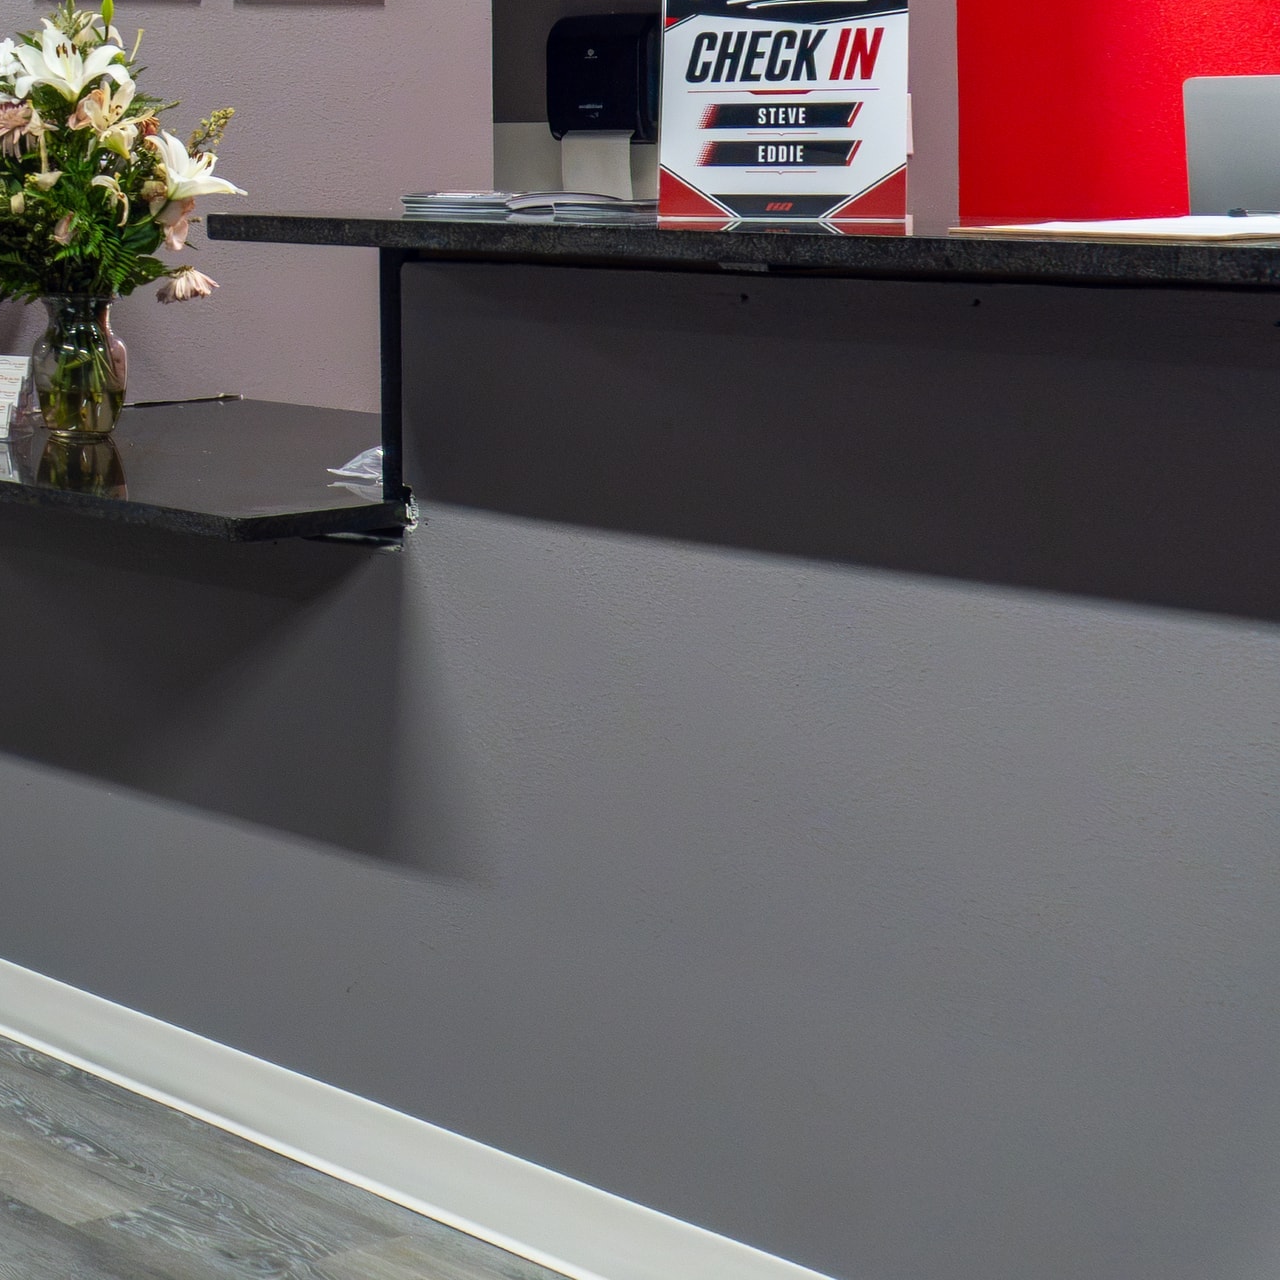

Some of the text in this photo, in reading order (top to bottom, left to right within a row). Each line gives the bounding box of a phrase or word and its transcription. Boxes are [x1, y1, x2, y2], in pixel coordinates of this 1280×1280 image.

[686, 27, 884, 83] CHECK IN
[758, 107, 806, 124] STEVE
[758, 144, 804, 163] EDDIE
